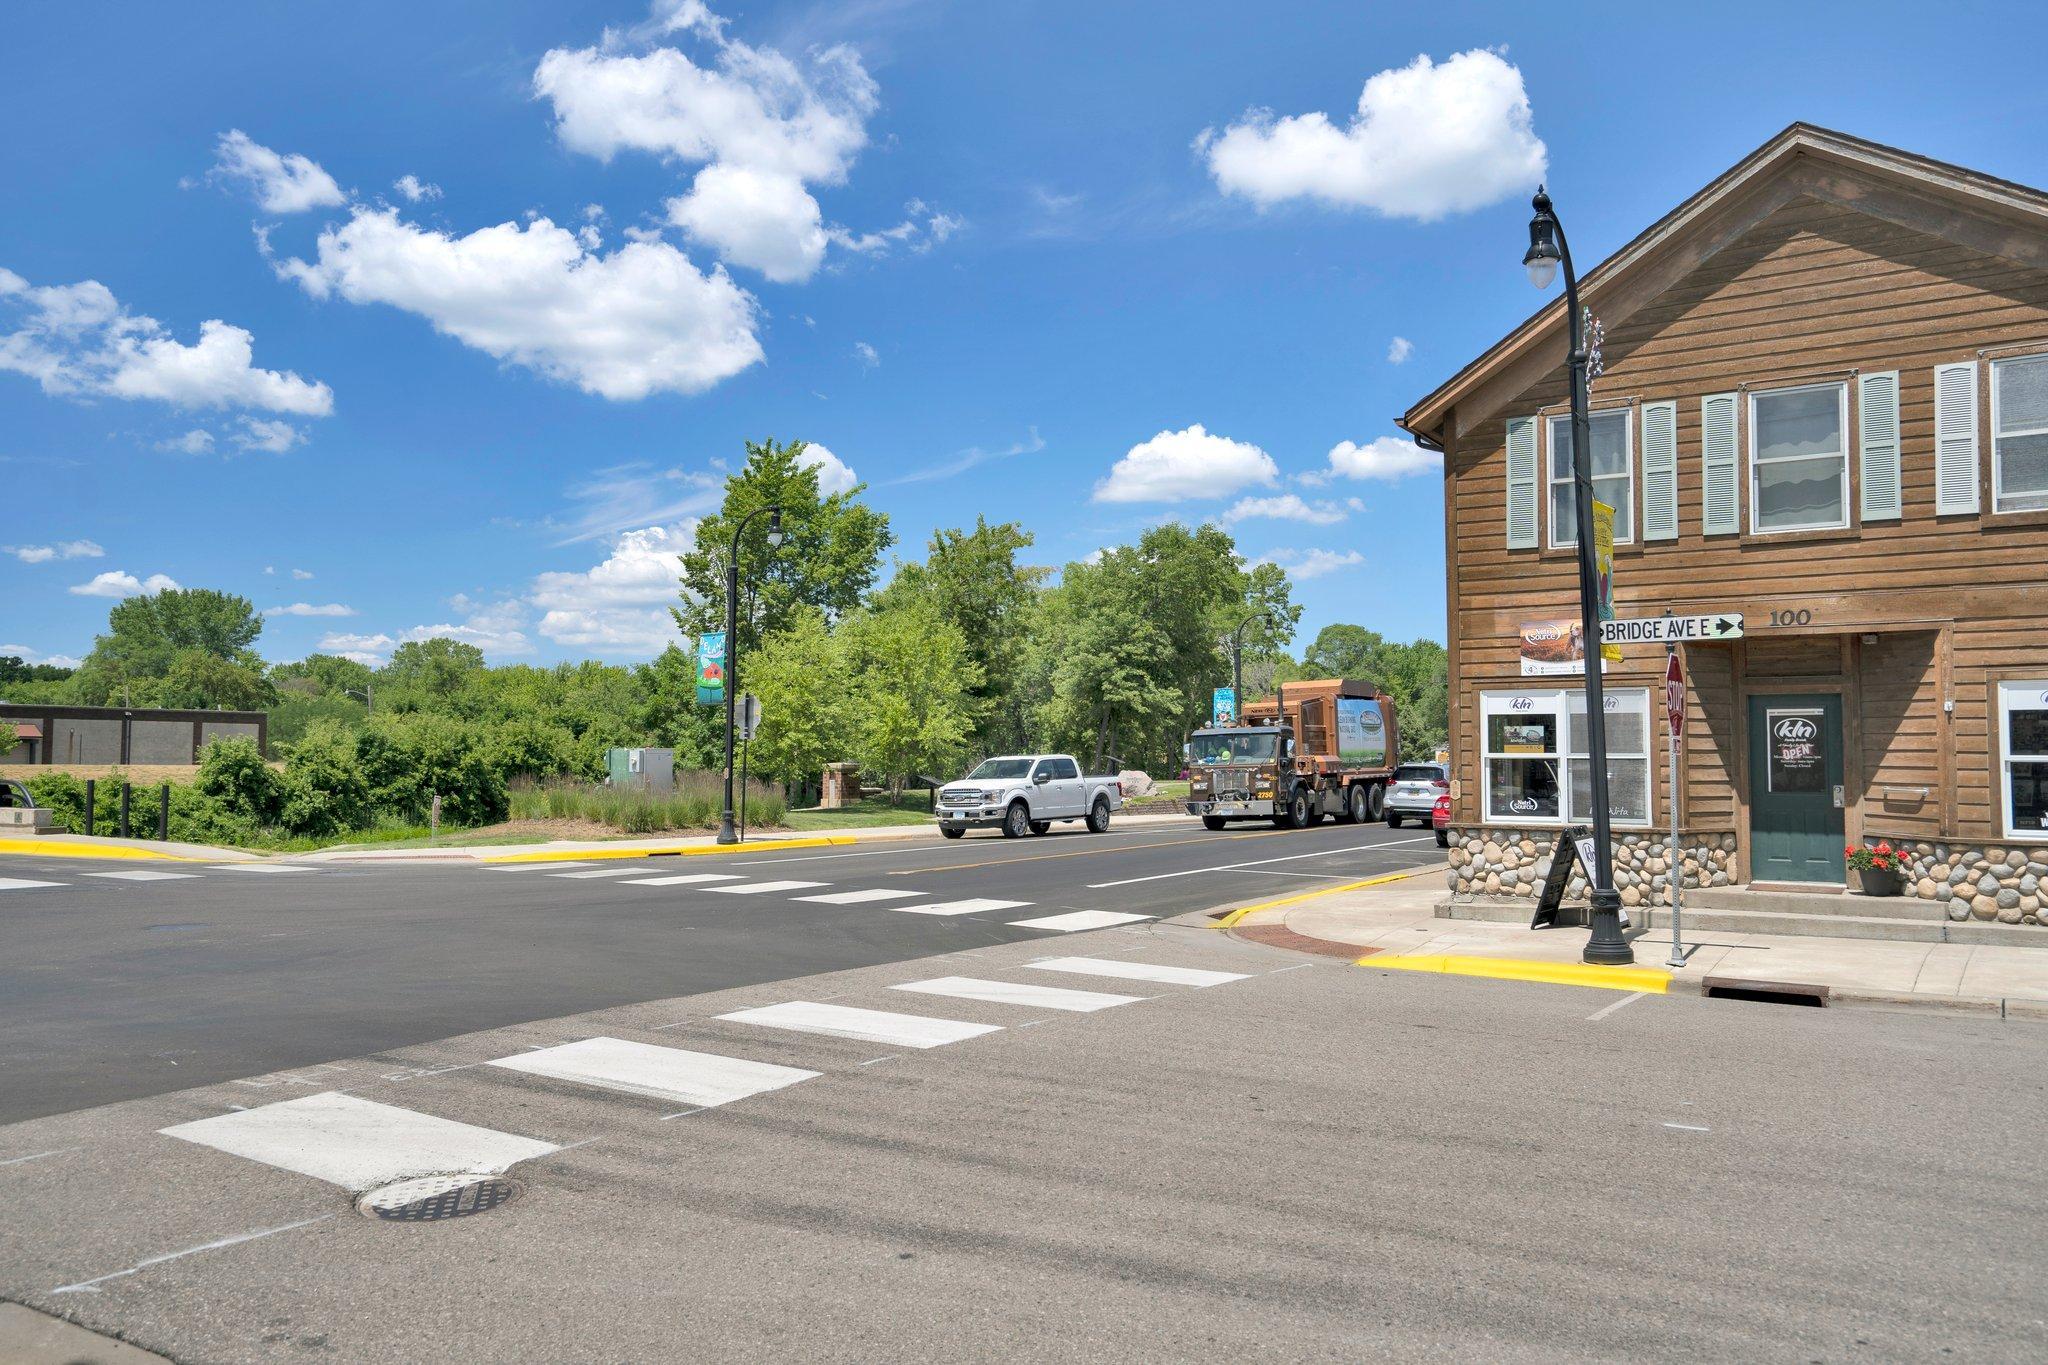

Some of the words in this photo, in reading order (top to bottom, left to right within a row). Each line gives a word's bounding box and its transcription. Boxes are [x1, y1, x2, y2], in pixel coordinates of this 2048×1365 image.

[1770, 609, 1812, 626] 100
[1606, 621, 1662, 640] BRIDGE
[1667, 620, 1696, 638] AVE
[1700, 618, 1710, 636] E
[1667, 680, 1683, 712] STOP
[1779, 720, 1812, 738] kln
[1782, 743, 1810, 760] OPEN
[1257, 790, 1274, 799] 2750
